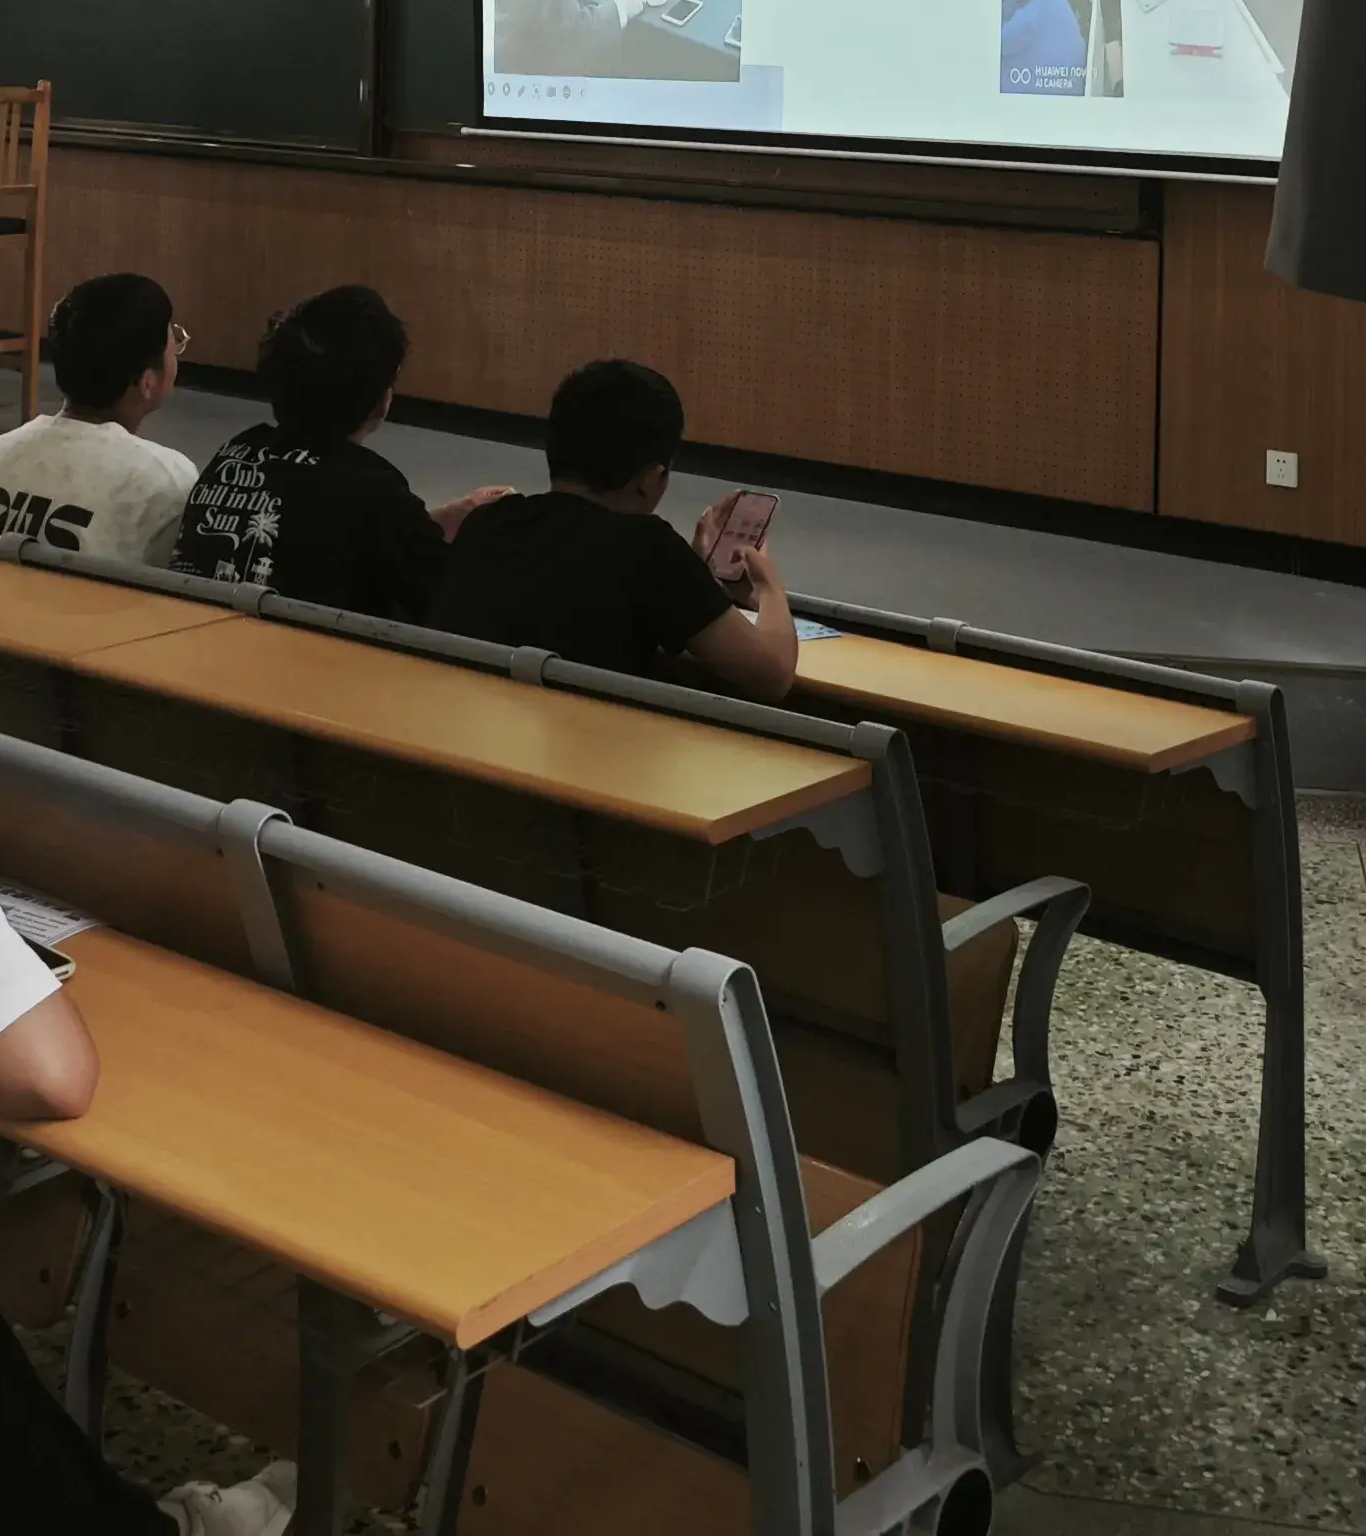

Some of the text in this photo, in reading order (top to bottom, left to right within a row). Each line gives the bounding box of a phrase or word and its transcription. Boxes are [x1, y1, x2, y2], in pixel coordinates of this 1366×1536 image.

[1035, 65, 1068, 77] HUAWEI
[1035, 78, 1073, 89] AI CAMERA
[220, 461, 266, 488] Club
[190, 484, 283, 514] Chill in the
[197, 506, 240, 535] Sun
